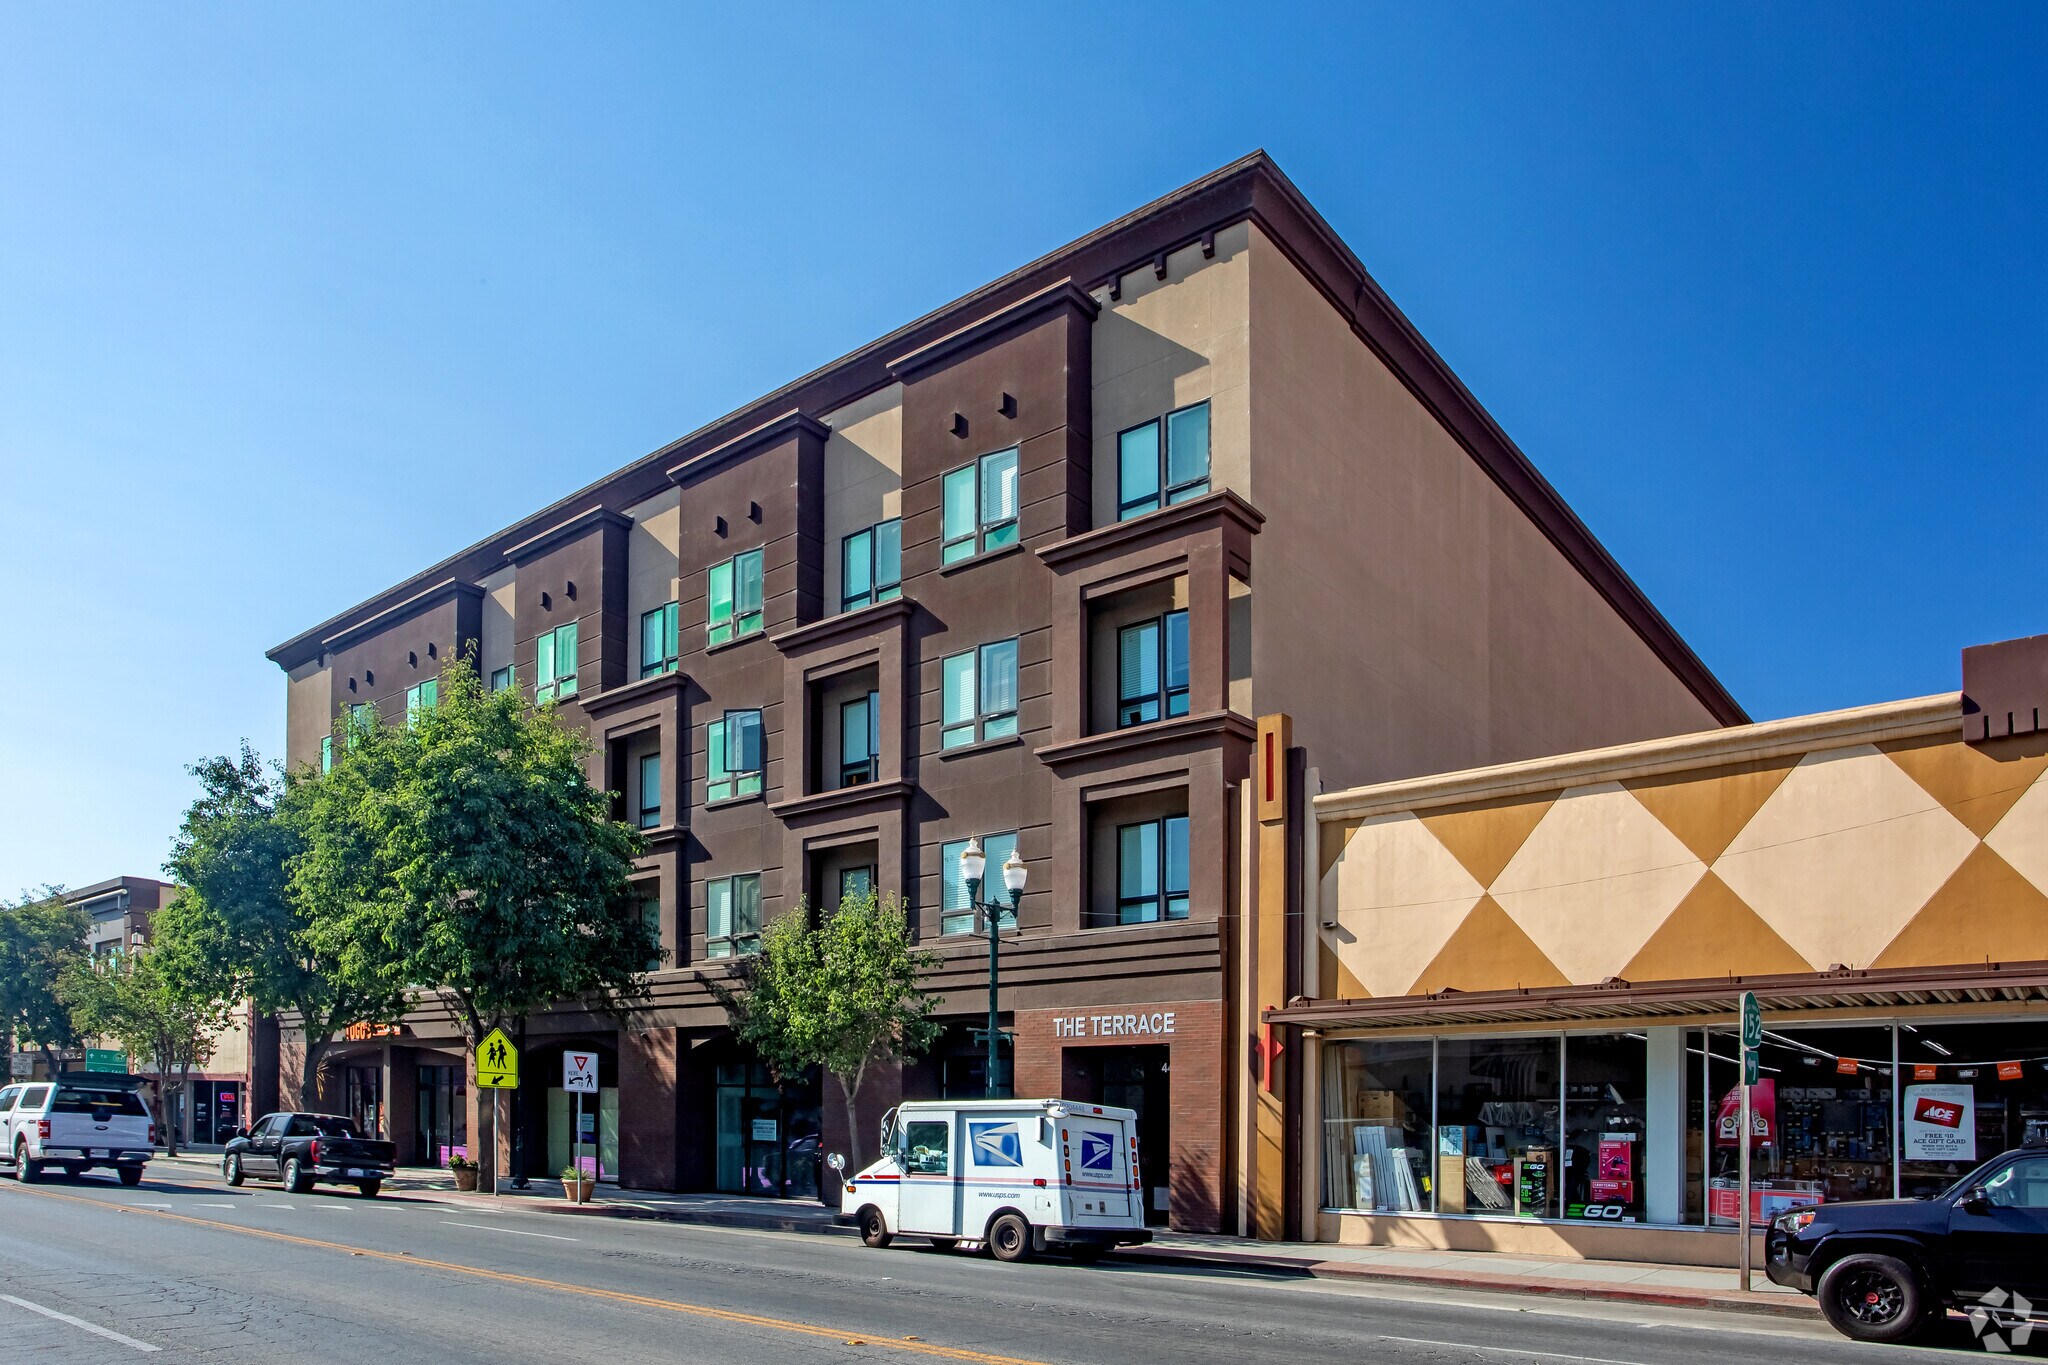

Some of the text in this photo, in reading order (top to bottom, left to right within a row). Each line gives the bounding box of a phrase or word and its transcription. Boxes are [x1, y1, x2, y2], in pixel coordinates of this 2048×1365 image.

[1053, 1012, 1175, 1037] THE TERRACE
[1745, 1013, 1761, 1040] 152
[1923, 1105, 1955, 1120] ACE
[1082, 1171, 1114, 1179] www.usps.com
[978, 1191, 1021, 1199] www.usps.com
[1521, 1189, 1532, 1197] 50+
[1566, 1203, 1623, 1218] EGO
